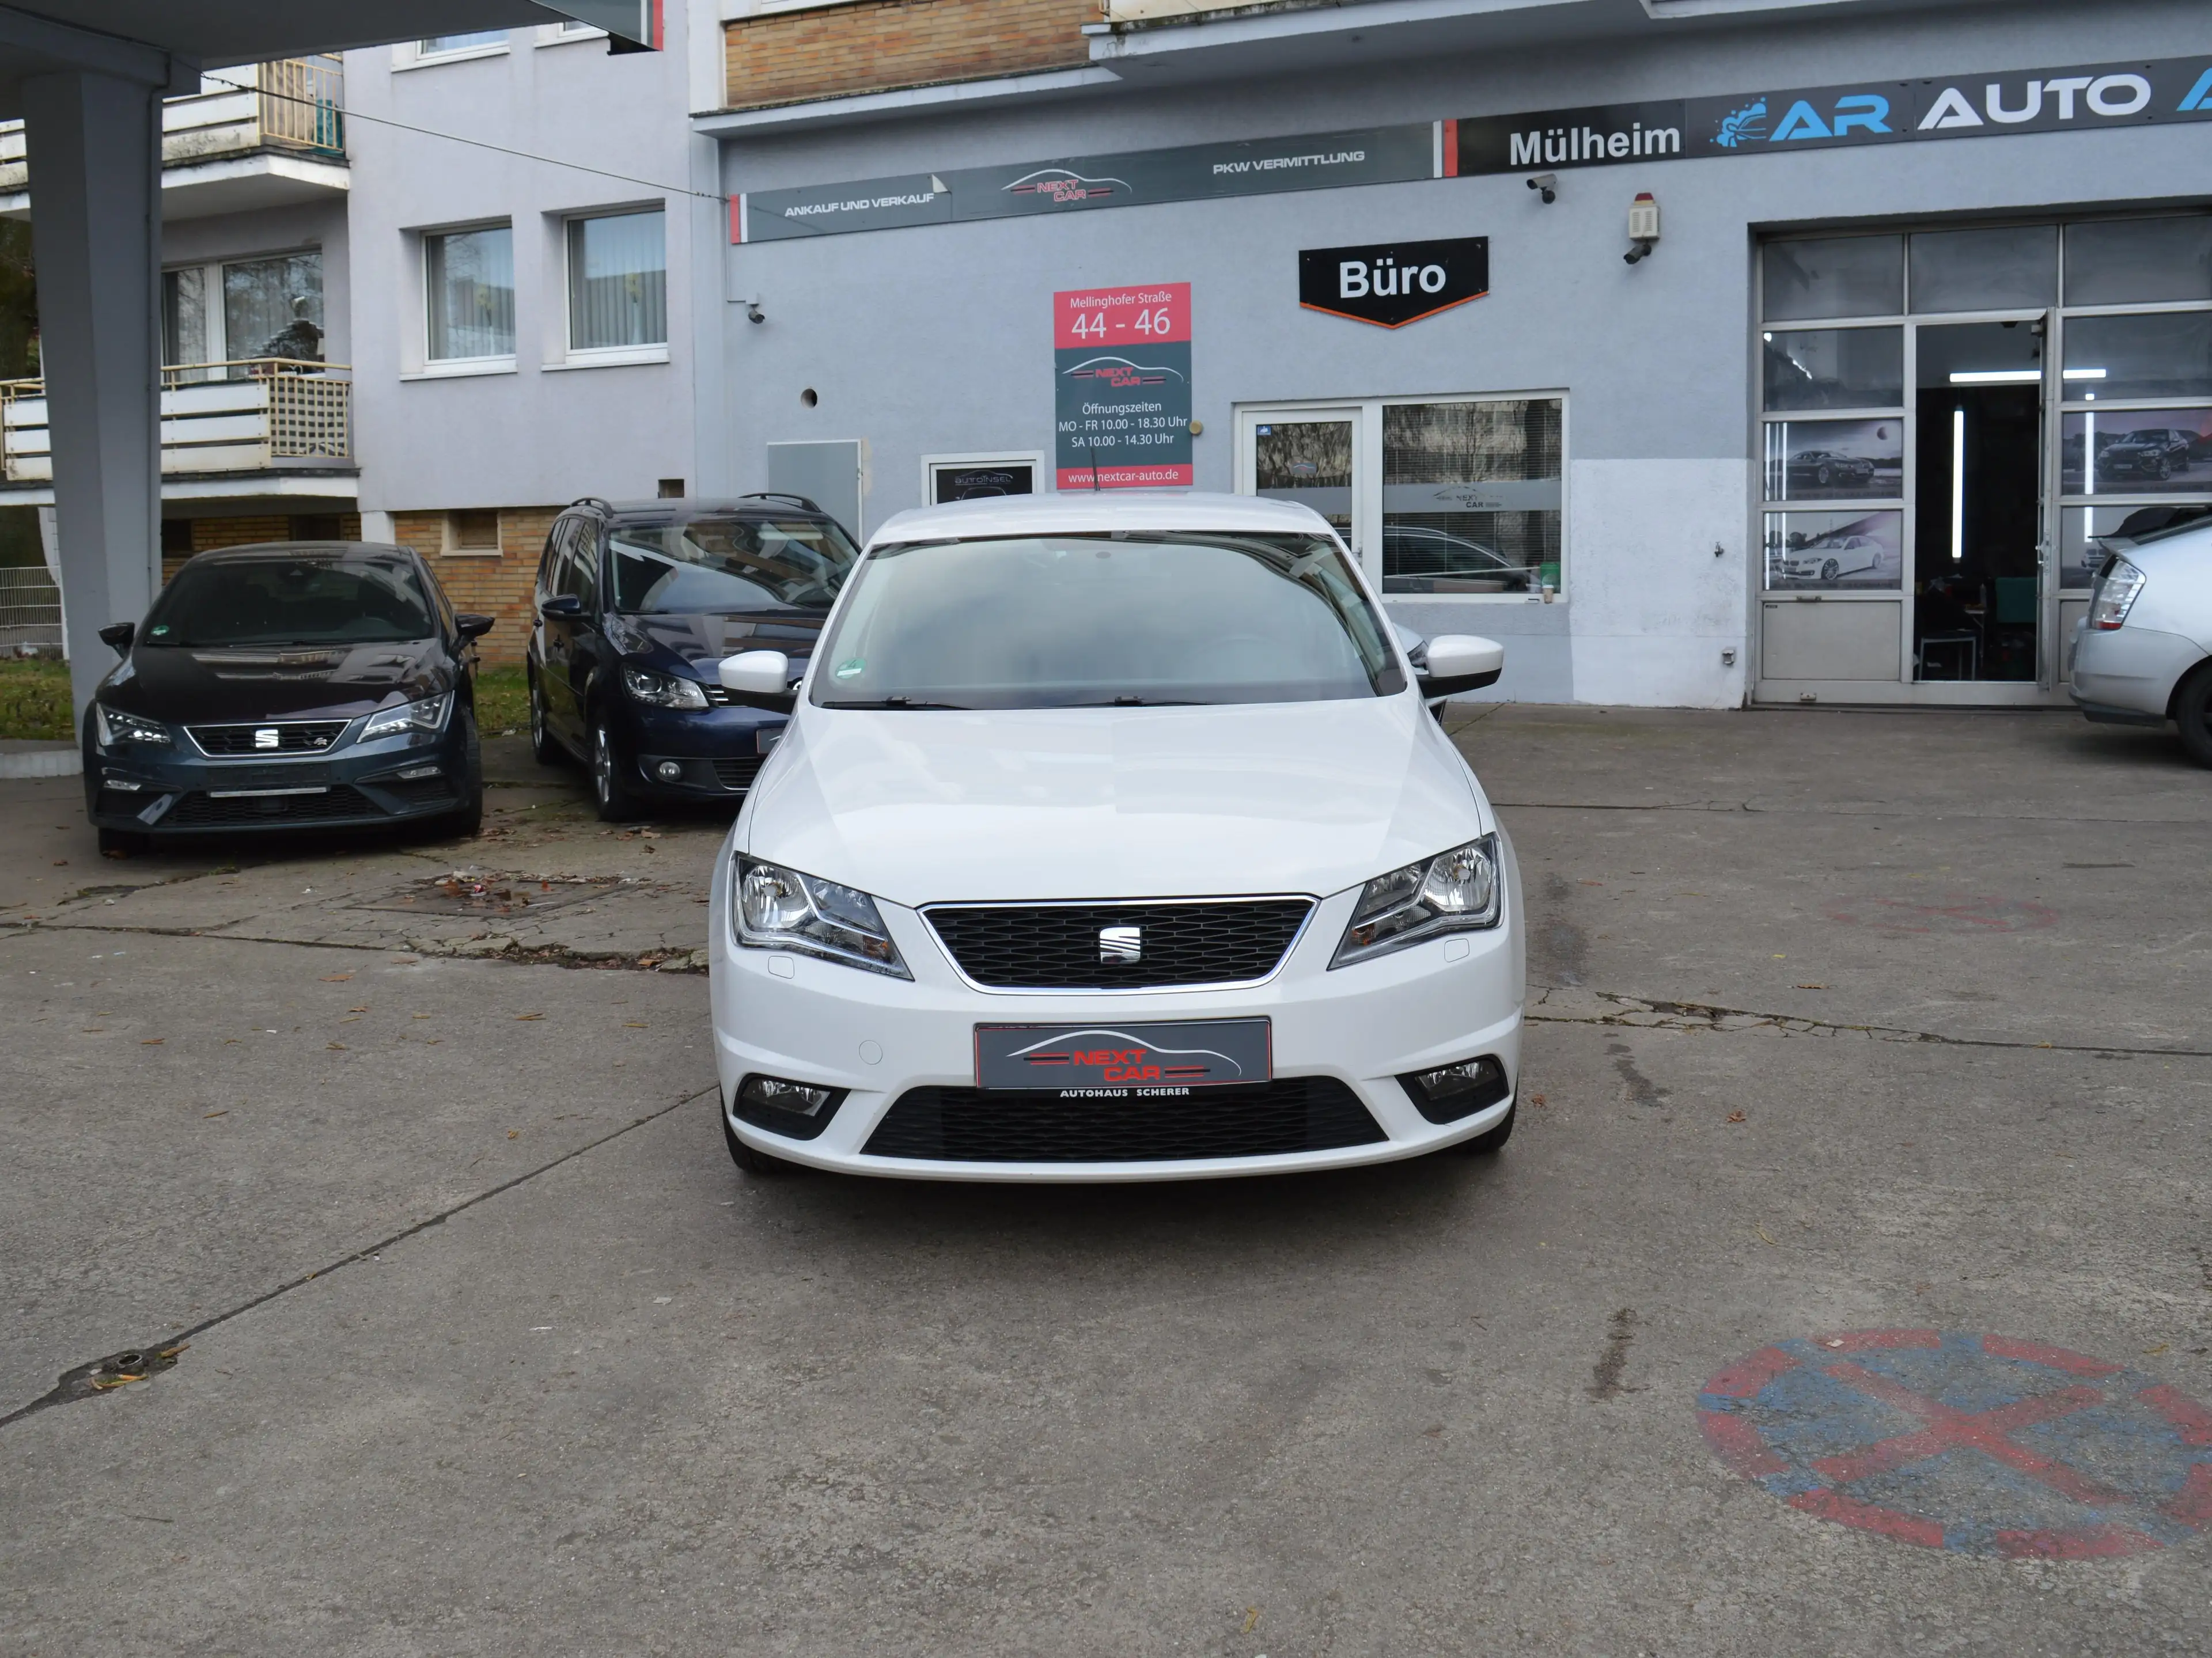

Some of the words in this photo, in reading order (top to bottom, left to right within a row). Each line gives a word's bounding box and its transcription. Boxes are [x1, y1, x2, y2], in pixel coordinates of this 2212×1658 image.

[1768, 94, 1893, 142] AR
[1917, 74, 2152, 131] AUTO
[1509, 122, 1680, 166] Mülheim
[1213, 161, 1251, 174] PKW
[1252, 150, 1365, 171] VERMITTLUNG
[1037, 179, 1079, 194] NEXT
[1054, 189, 1086, 202] CAR
[784, 203, 839, 217] ANKAUF
[840, 199, 869, 212] UND
[870, 192, 935, 208] VERKAUF
[1339, 257, 1446, 299] Büro
[1070, 293, 1135, 309] Mellinghofer
[1138, 291, 1172, 305] Straße
[1071, 312, 1107, 340] 44
[1134, 307, 1171, 336] 46
[1094, 367, 1134, 378] NEXT
[1111, 376, 1141, 388] CAR
[1082, 402, 1162, 416] Öffnungszeiten
[1058, 420, 1077, 432] MO
[1085, 419, 1099, 431] FR
[1101, 419, 1128, 430] 10.00
[1137, 417, 1165, 428] 18.30
[1168, 416, 1188, 427] Uhr
[1071, 436, 1085, 448] SA
[1088, 435, 1115, 447] 10.00
[1124, 434, 1152, 445] 14.30
[1154, 432, 1174, 445] Uhr
[1068, 469, 1179, 483] wwwnextcar-auto.de
[1074, 1049, 1147, 1066] NEXT
[1104, 1065, 1160, 1082] CAR
[1060, 1088, 1128, 1098] AUTOHAUS
[1137, 1087, 1190, 1097] SCHERER
